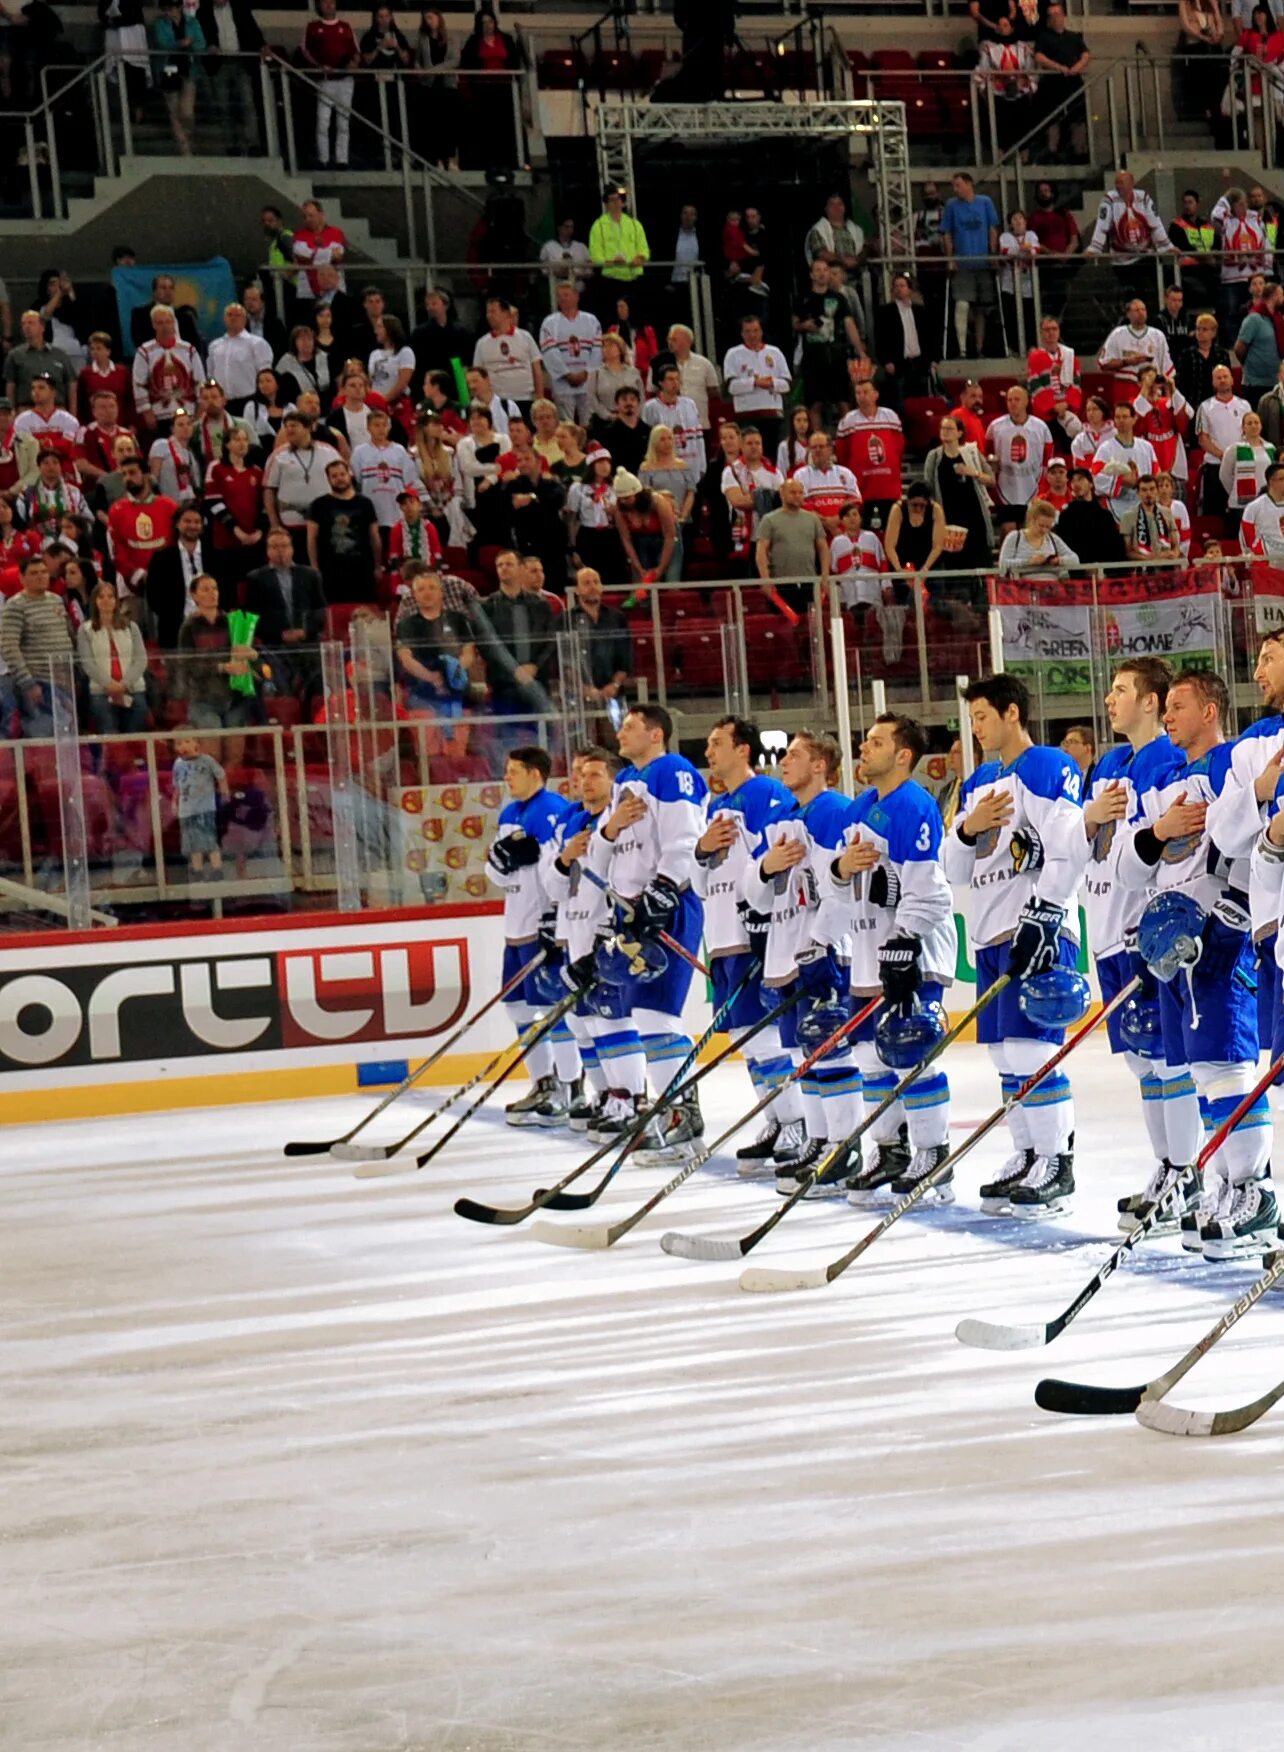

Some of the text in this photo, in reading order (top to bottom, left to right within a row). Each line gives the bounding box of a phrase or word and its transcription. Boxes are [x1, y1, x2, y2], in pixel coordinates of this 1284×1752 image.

[1121, 633, 1173, 655] HOME
[675, 770, 695, 797] 18
[1061, 765, 1081, 802] 24
[915, 822, 931, 851] 3
[1098, 1166, 1196, 1289] EASTON
